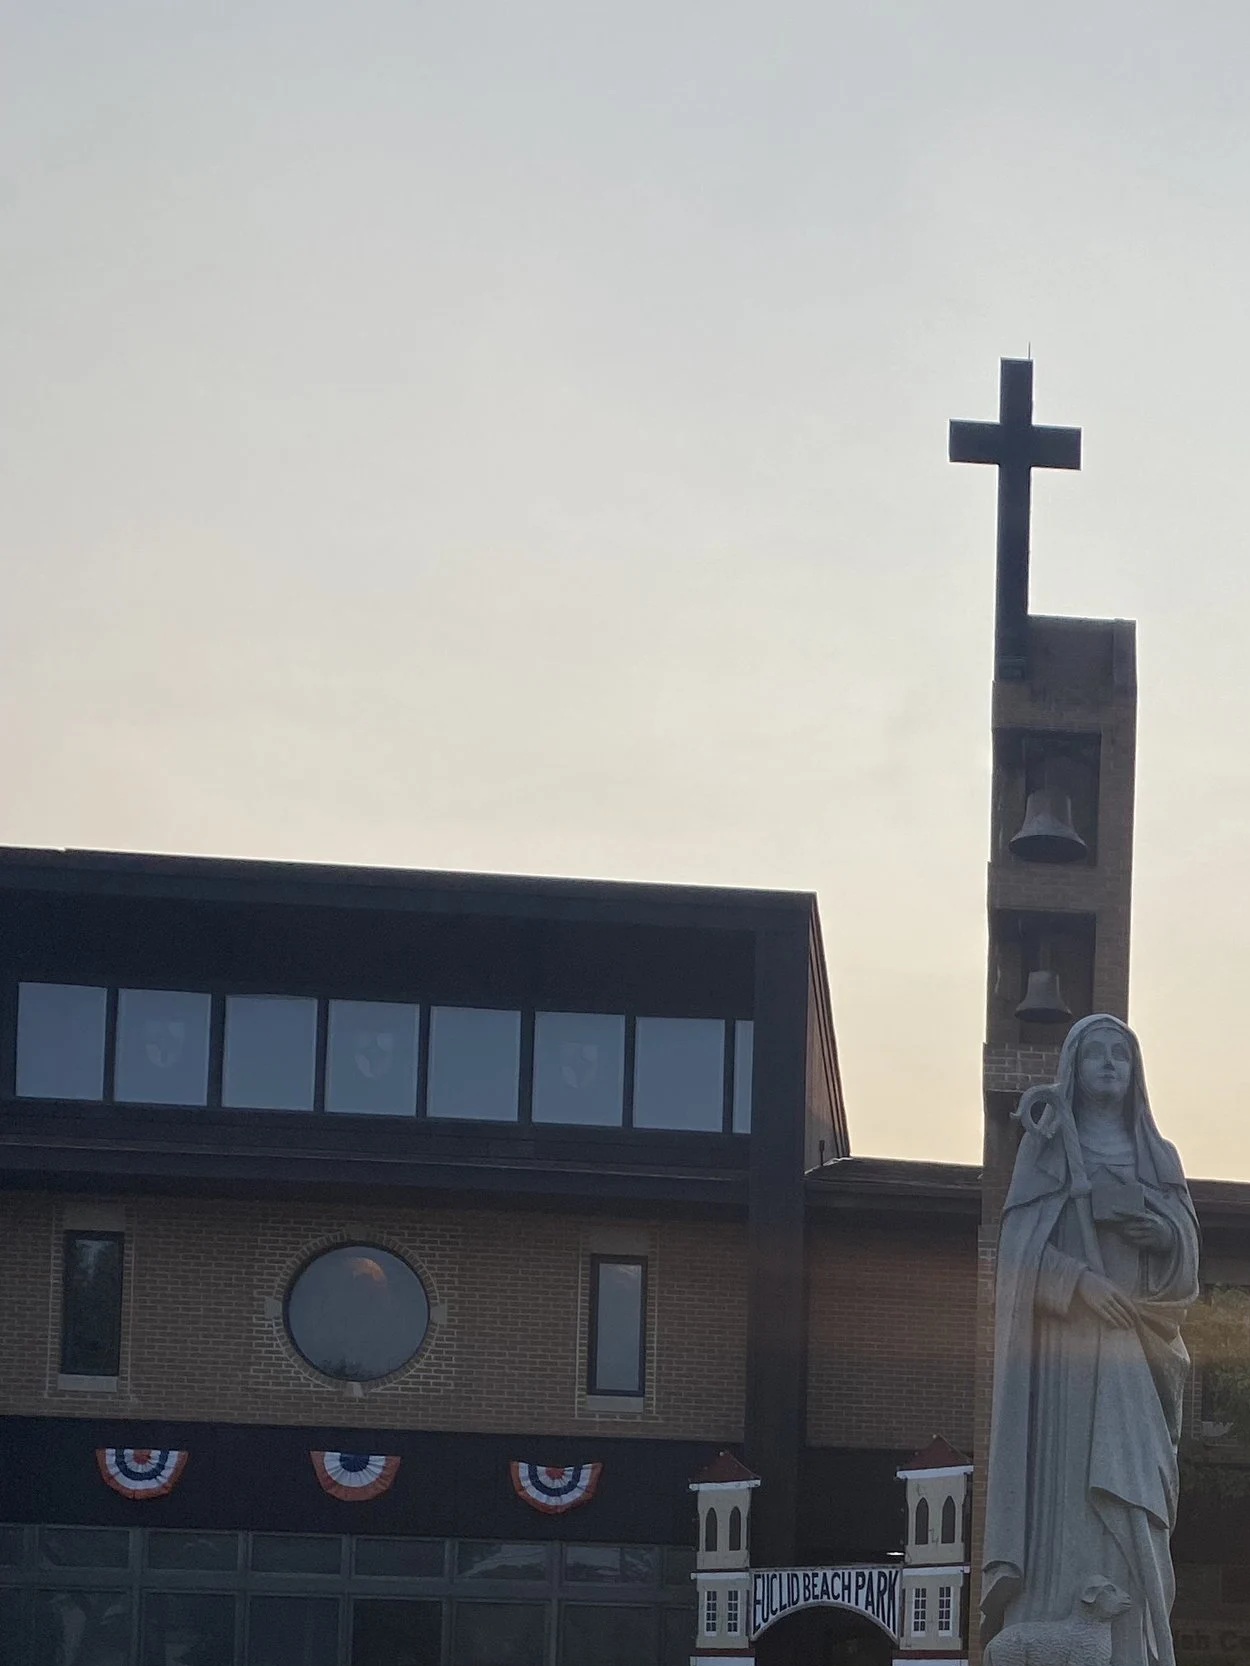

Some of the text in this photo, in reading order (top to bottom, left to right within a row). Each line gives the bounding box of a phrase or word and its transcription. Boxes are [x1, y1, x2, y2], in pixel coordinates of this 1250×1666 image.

[753, 1571, 899, 1634] EUCLID BEACH PARK
